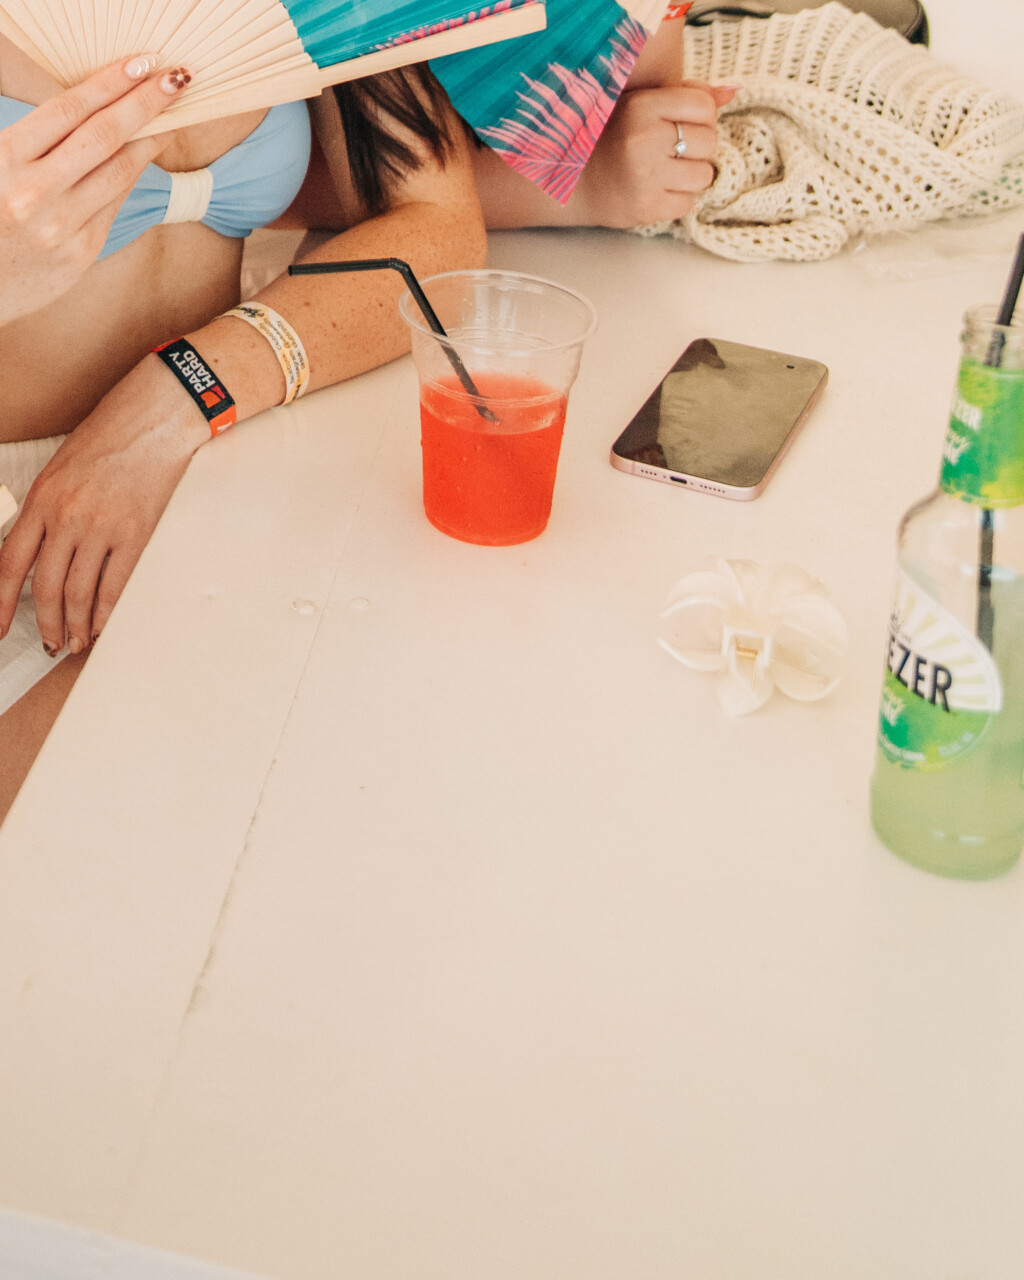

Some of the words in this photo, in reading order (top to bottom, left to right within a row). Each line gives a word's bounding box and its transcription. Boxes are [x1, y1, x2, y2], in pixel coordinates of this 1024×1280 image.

[169, 351, 206, 394] PARTY
[183, 349, 216, 388] HARD
[887, 634, 952, 713] EZER
